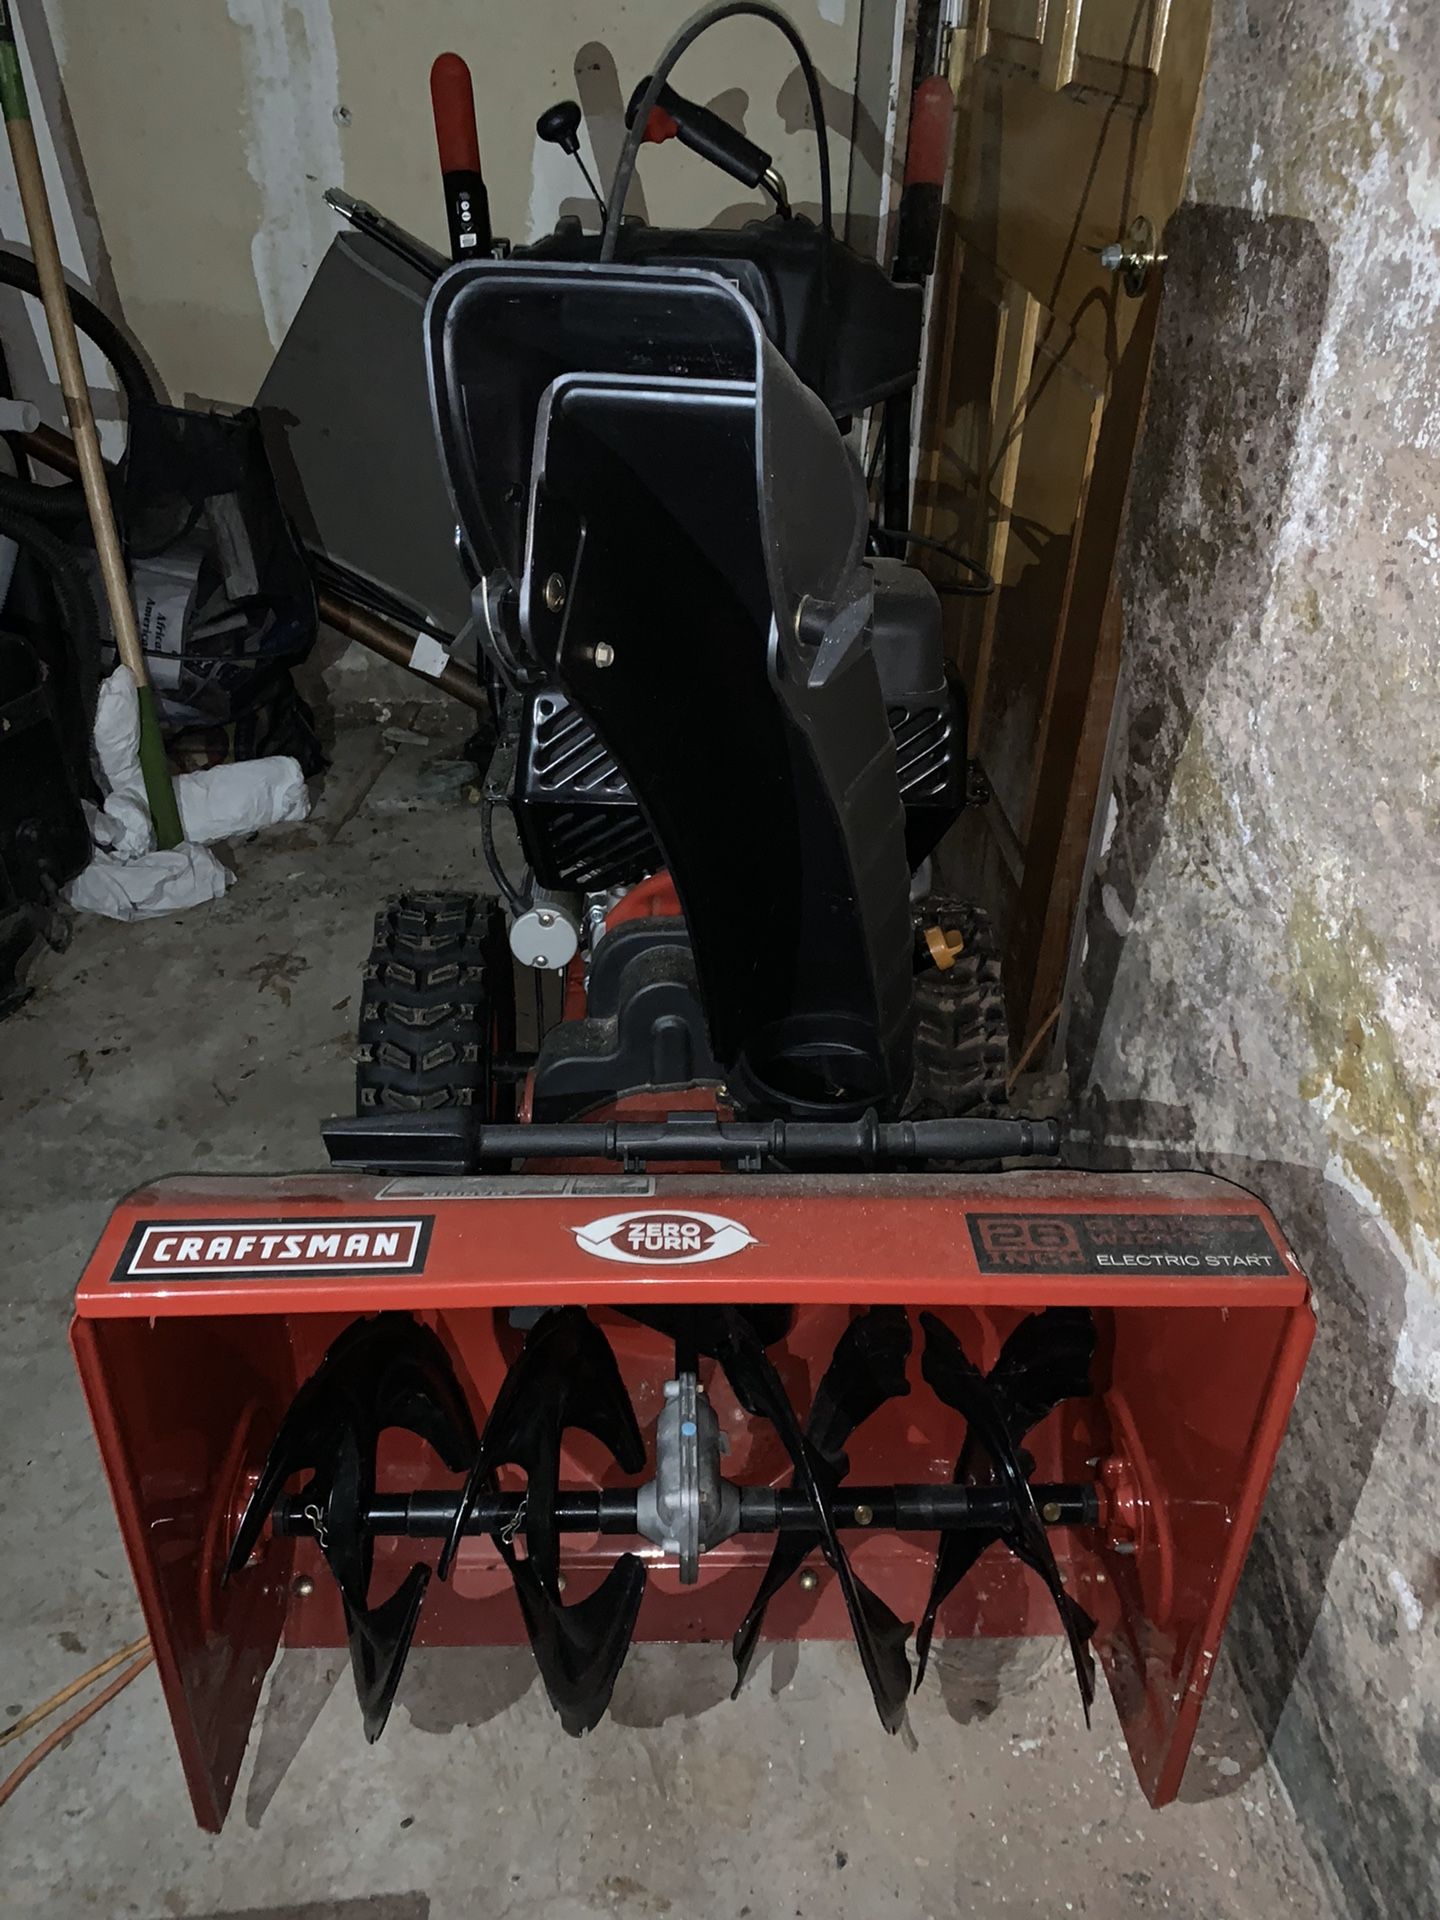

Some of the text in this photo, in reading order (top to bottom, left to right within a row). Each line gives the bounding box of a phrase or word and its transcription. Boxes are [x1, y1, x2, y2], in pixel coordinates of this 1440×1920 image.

[142, 597, 156, 652] America
[155, 611, 167, 652] Africa
[628, 1223, 701, 1237] ZERO
[153, 1233, 400, 1261] CRAFTSMAN
[627, 1236, 701, 1250] TURN
[1096, 1254, 1272, 1267] ELECTRIC START
